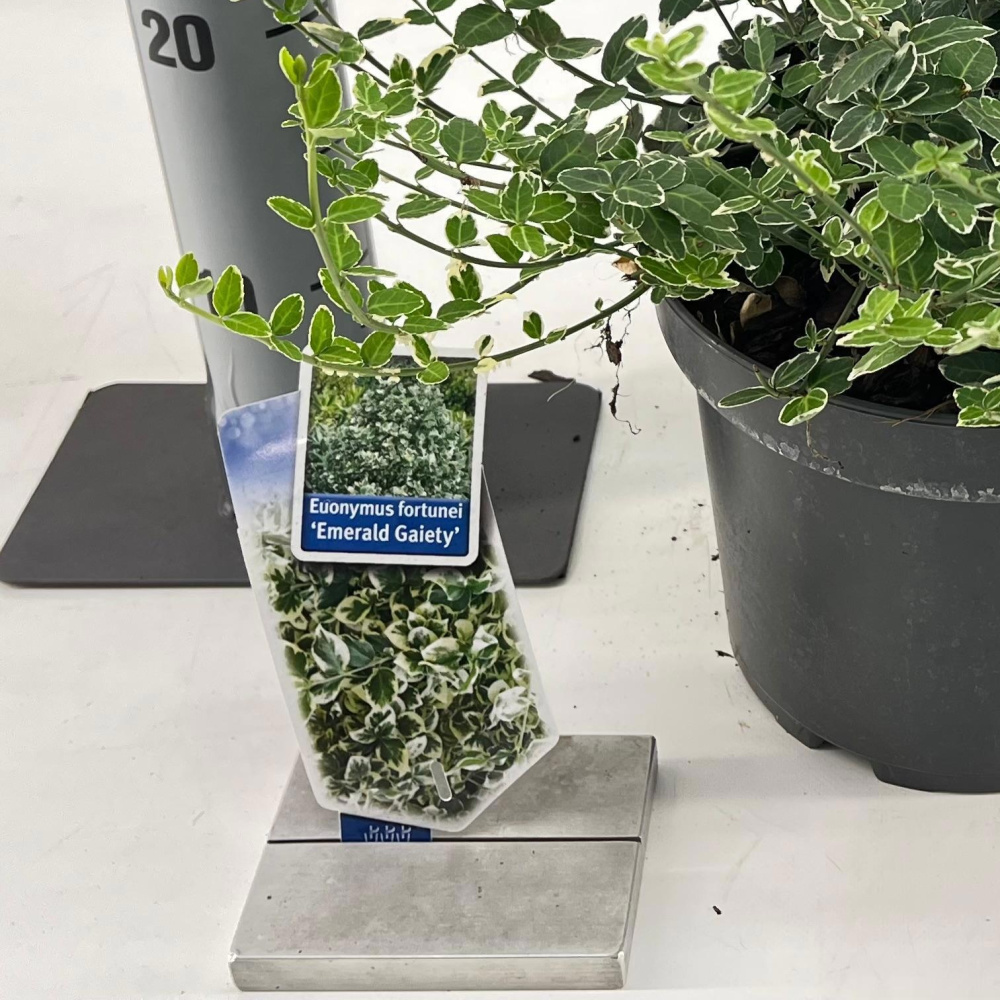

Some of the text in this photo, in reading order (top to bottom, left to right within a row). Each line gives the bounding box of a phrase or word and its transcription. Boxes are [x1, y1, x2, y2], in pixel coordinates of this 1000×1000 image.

[142, 9, 215, 72] 20
[310, 498, 463, 519] Euonymus fortunei
